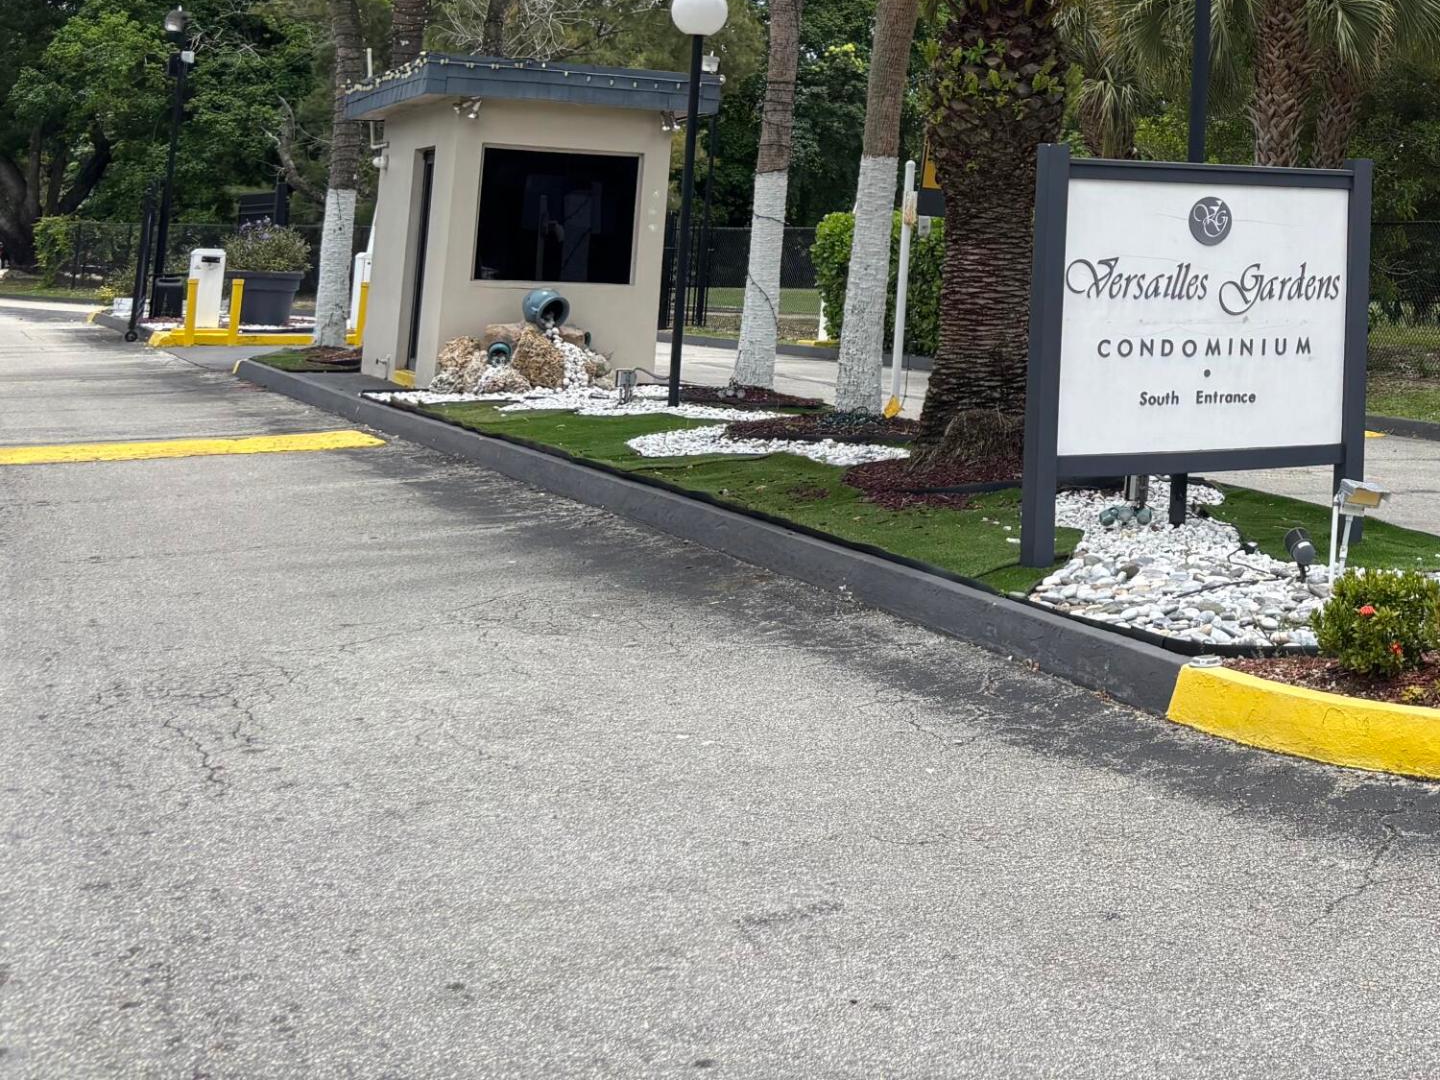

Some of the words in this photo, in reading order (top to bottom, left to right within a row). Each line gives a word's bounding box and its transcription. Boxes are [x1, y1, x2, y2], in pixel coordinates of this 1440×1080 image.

[1065, 256, 1208, 300] Versailles
[1218, 262, 1341, 316] Gardens
[1097, 336, 1312, 359] CONDOMINIUM
[1139, 390, 1180, 407] South
[1195, 390, 1256, 406] Entrance
